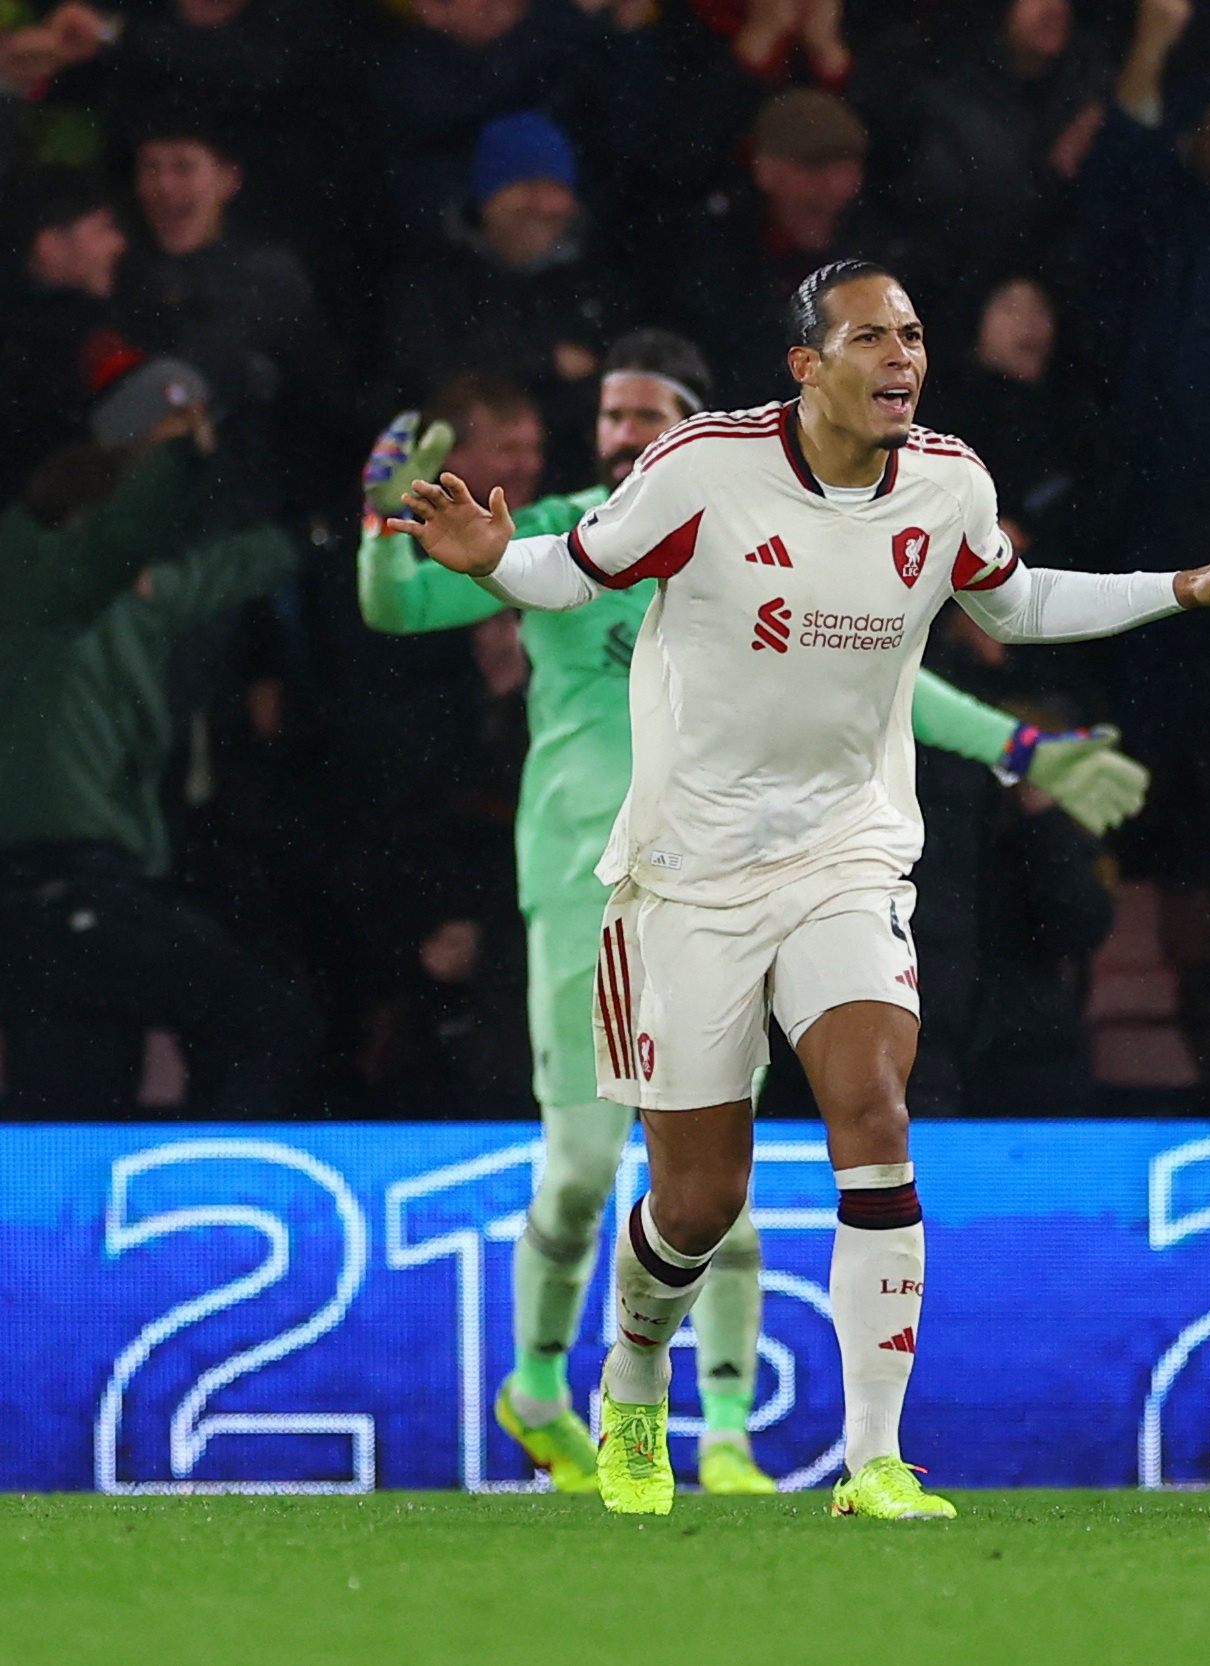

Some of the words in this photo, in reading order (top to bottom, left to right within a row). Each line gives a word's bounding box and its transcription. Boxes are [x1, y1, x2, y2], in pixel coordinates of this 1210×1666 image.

[902, 566, 920, 578] LFC
[802, 610, 906, 633] standard
[799, 630, 905, 651] chartered
